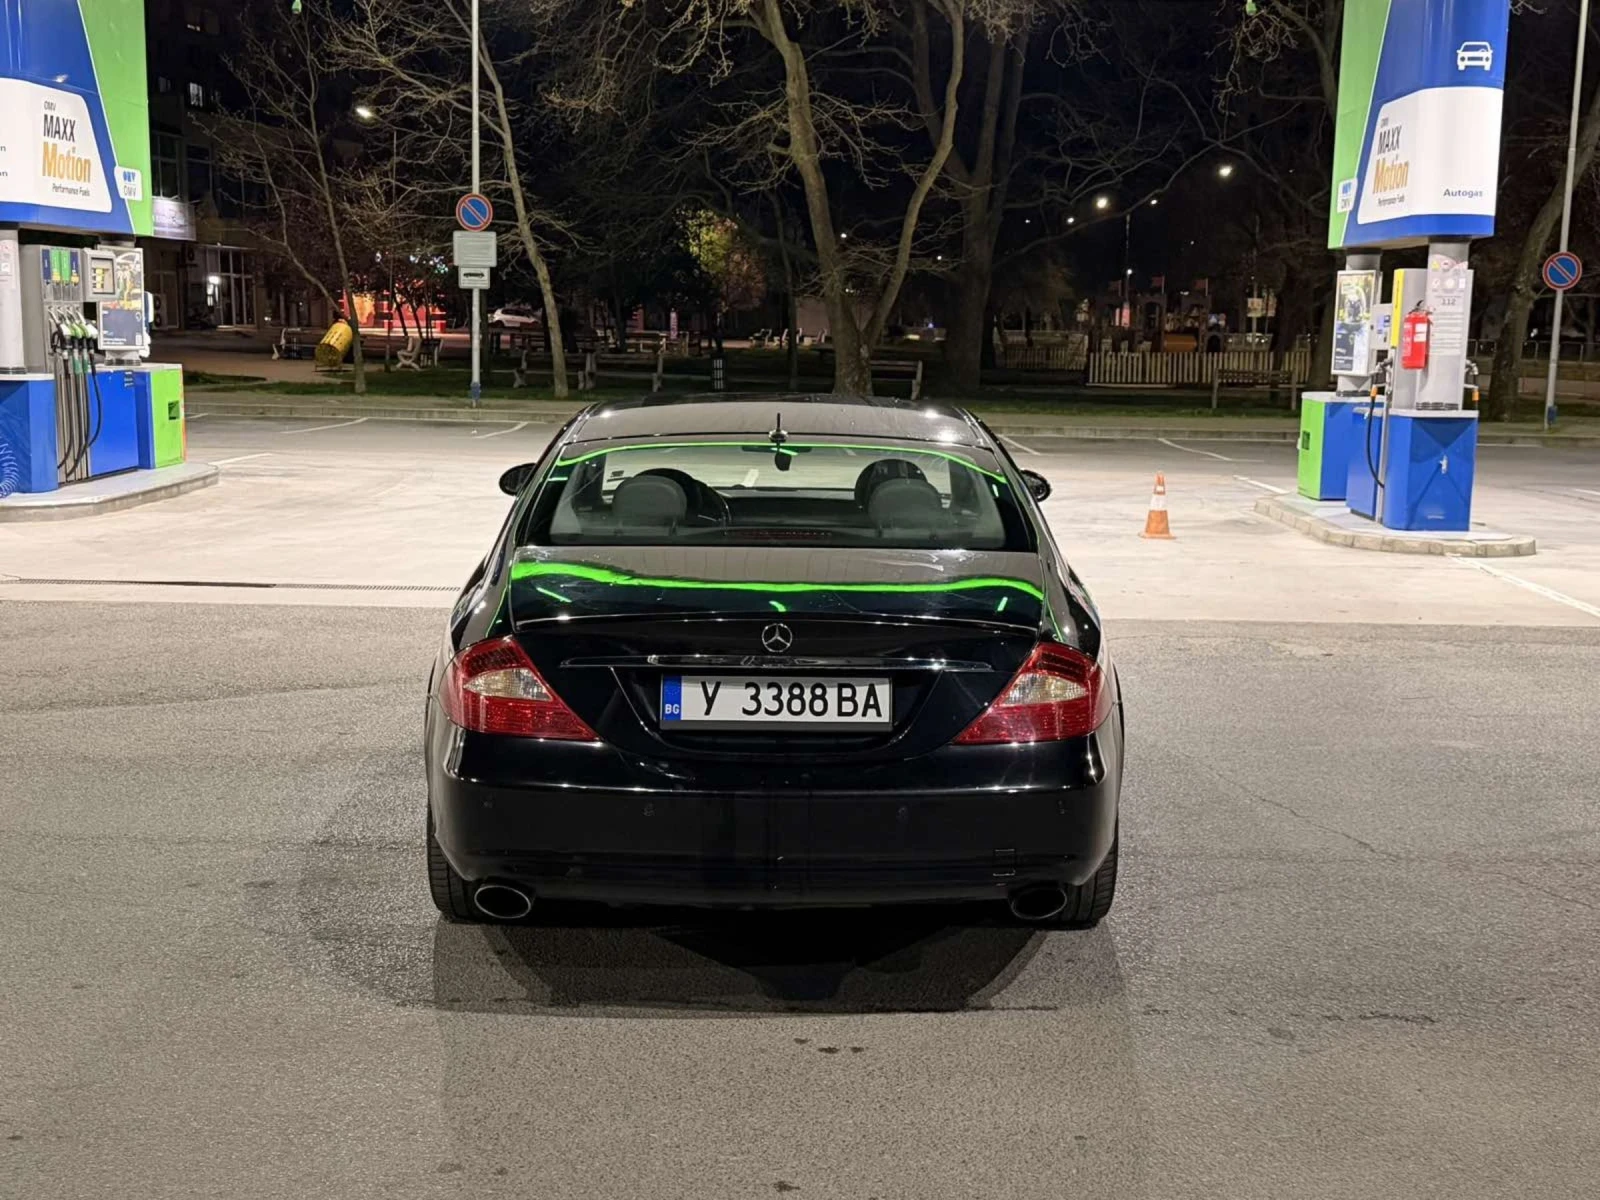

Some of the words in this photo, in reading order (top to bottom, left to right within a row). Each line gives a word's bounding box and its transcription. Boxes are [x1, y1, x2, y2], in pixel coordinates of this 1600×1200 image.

[44, 100, 56, 111] OMV
[43, 114, 76, 142] MAXX
[1378, 125, 1402, 155] MAXX
[42, 141, 91, 183] Motion
[1373, 154, 1409, 194] Motion
[1443, 188, 1483, 199] Autogas
[665, 704, 680, 715] BG
